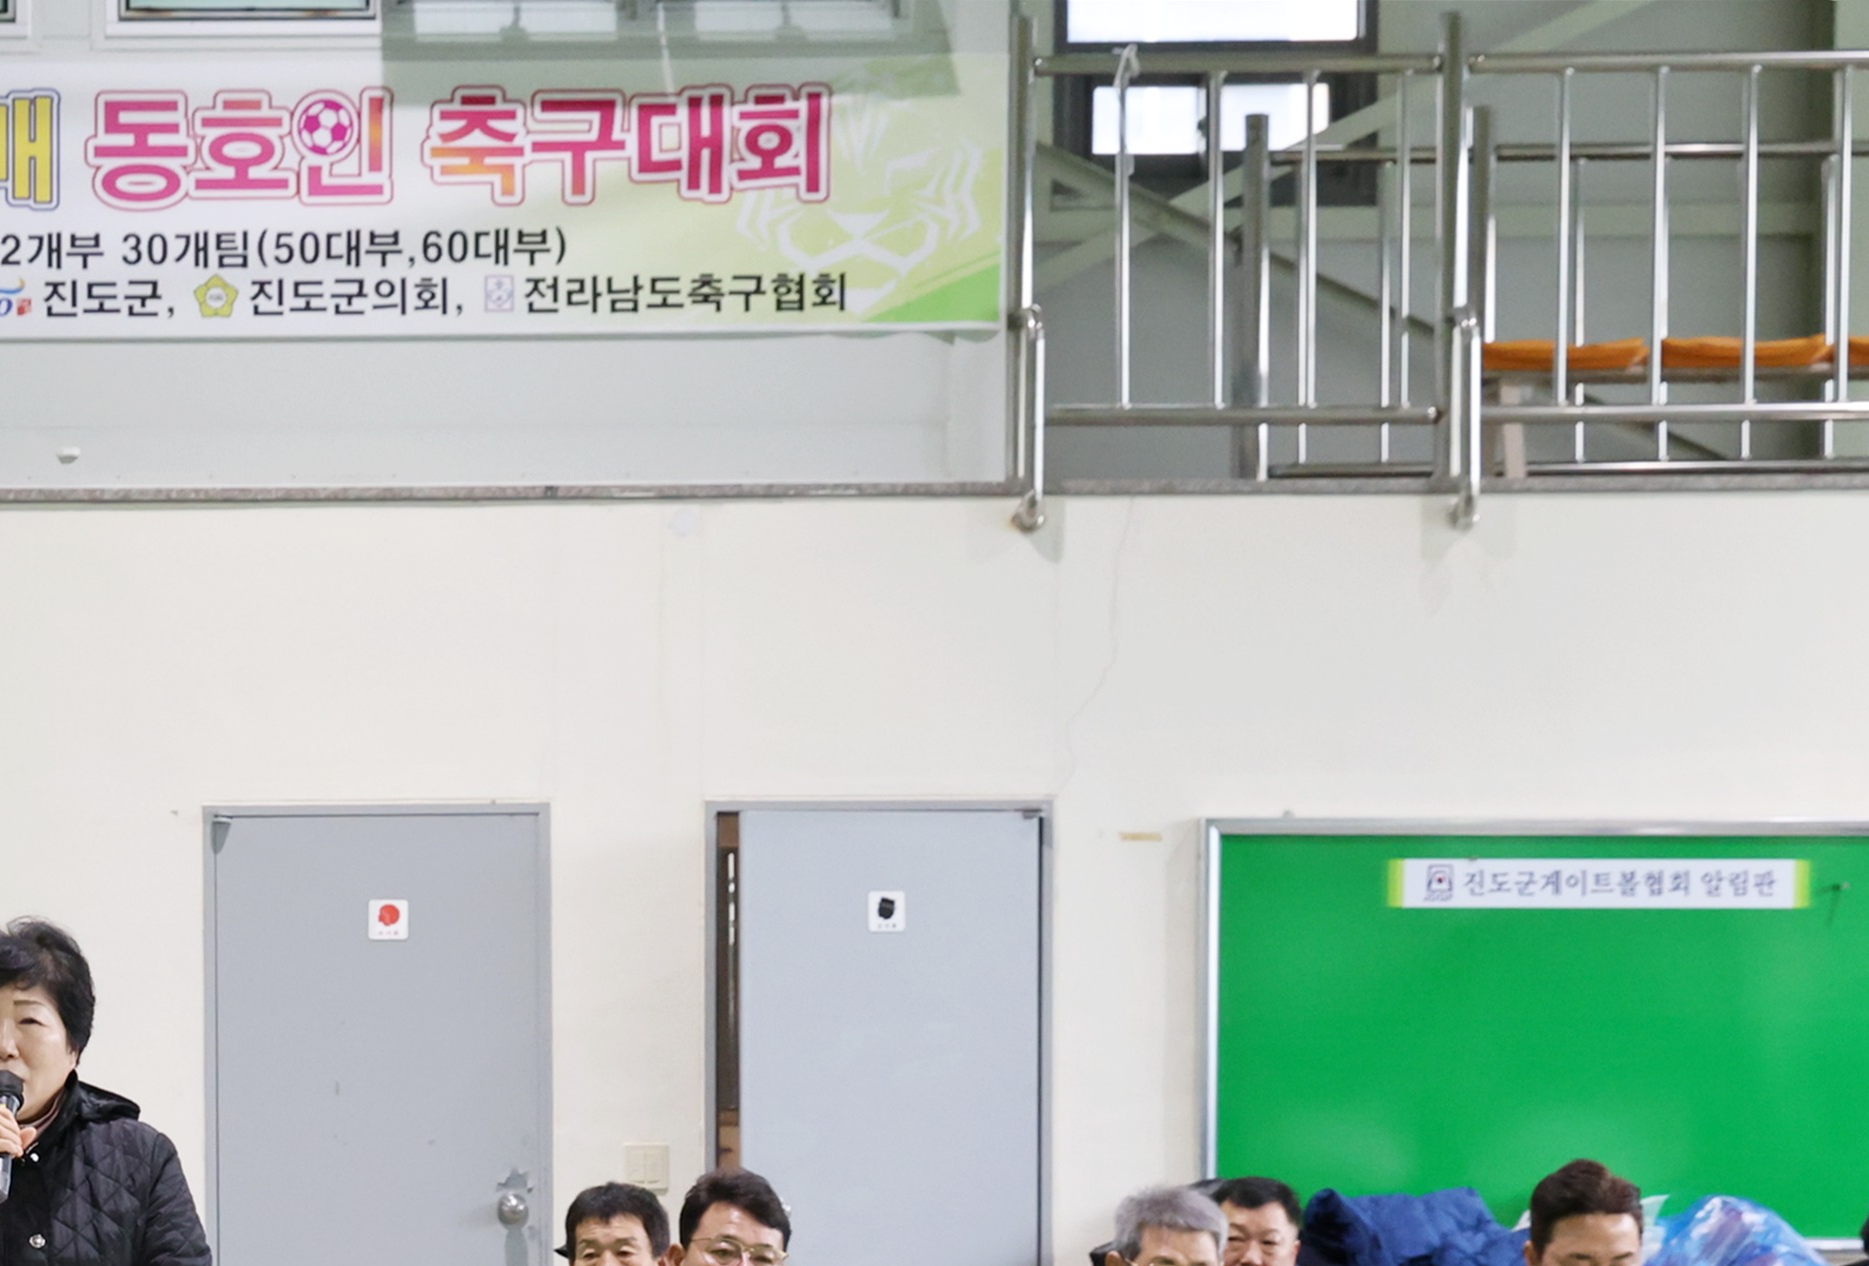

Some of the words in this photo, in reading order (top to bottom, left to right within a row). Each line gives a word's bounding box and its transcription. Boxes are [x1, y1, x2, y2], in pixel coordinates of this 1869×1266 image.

[88, 88, 392, 209] 동호인
[425, 86, 831, 205] 축구대회
[1, 232, 106, 270] 2개부
[44, 280, 176, 319] 진도군,
[250, 278, 464, 317] 진도군의회,
[525, 273, 848, 315] 전라남도축구협회
[1464, 870, 1691, 897] 진도군게이트볼협회
[1700, 870, 1776, 897] 알림판
